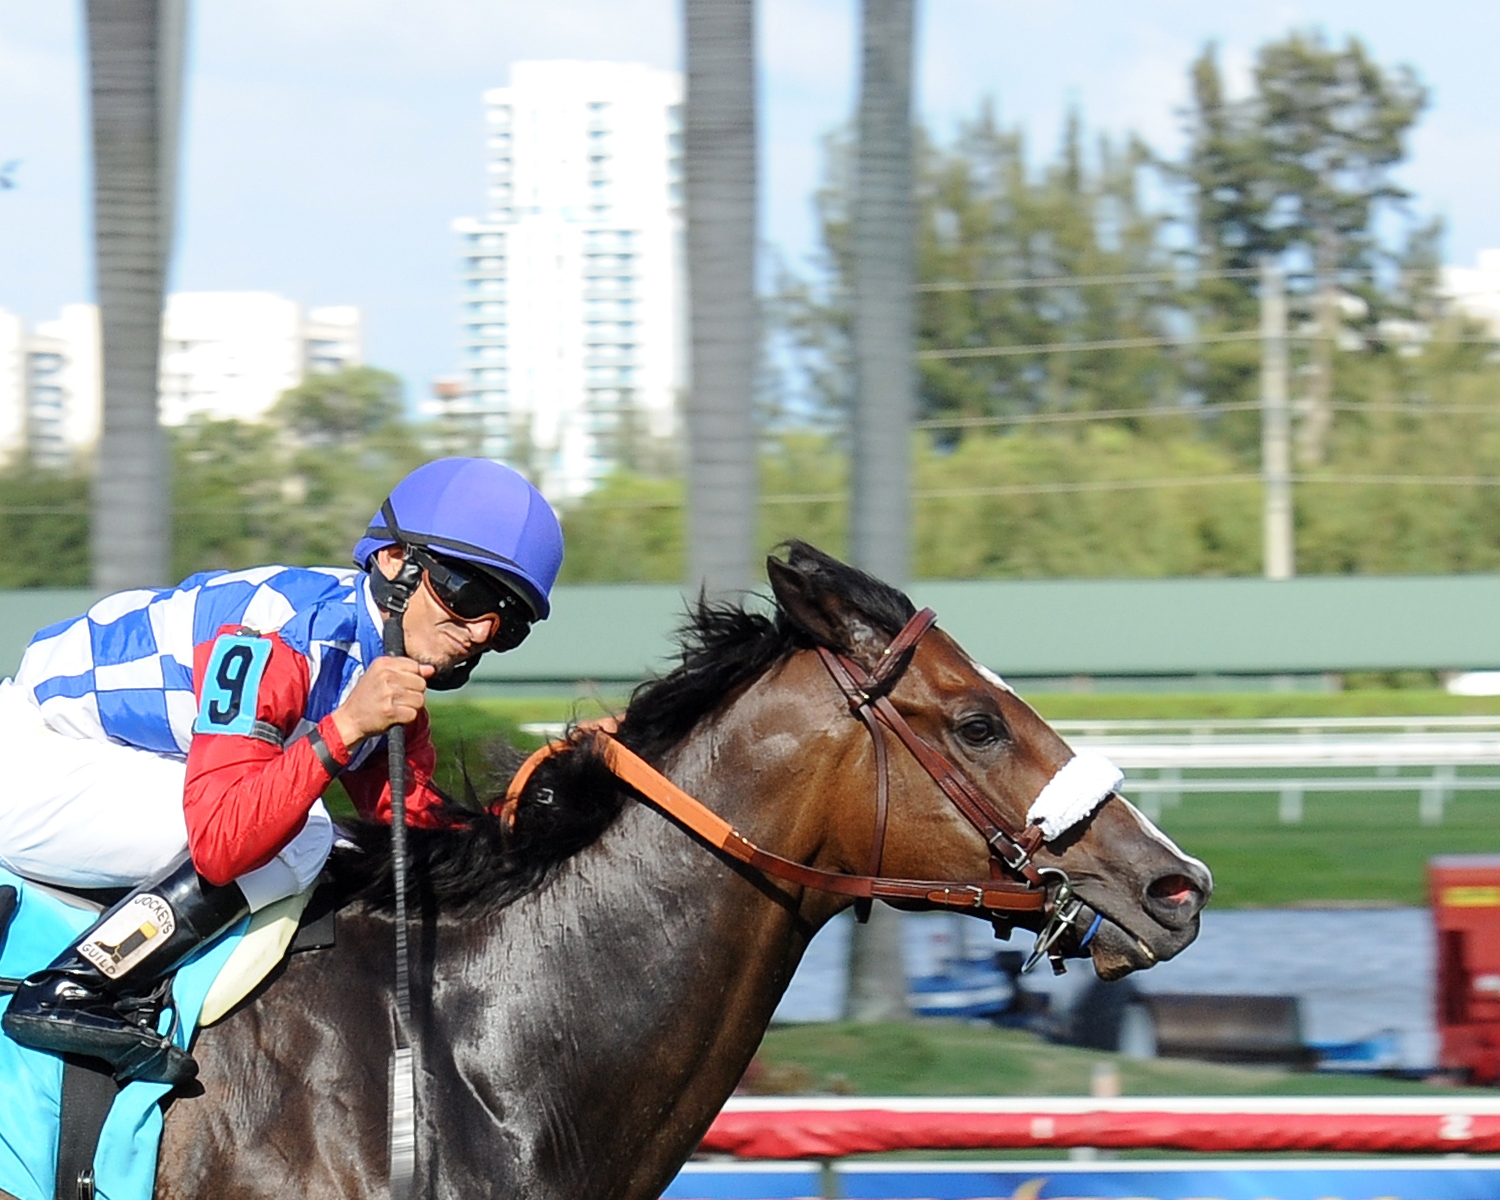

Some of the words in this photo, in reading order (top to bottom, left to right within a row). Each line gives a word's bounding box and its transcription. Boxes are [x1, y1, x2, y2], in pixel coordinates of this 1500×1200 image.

[207, 644, 254, 726] 9
[134, 896, 173, 935] JOCKEYS
[82, 943, 116, 975] GUILD
